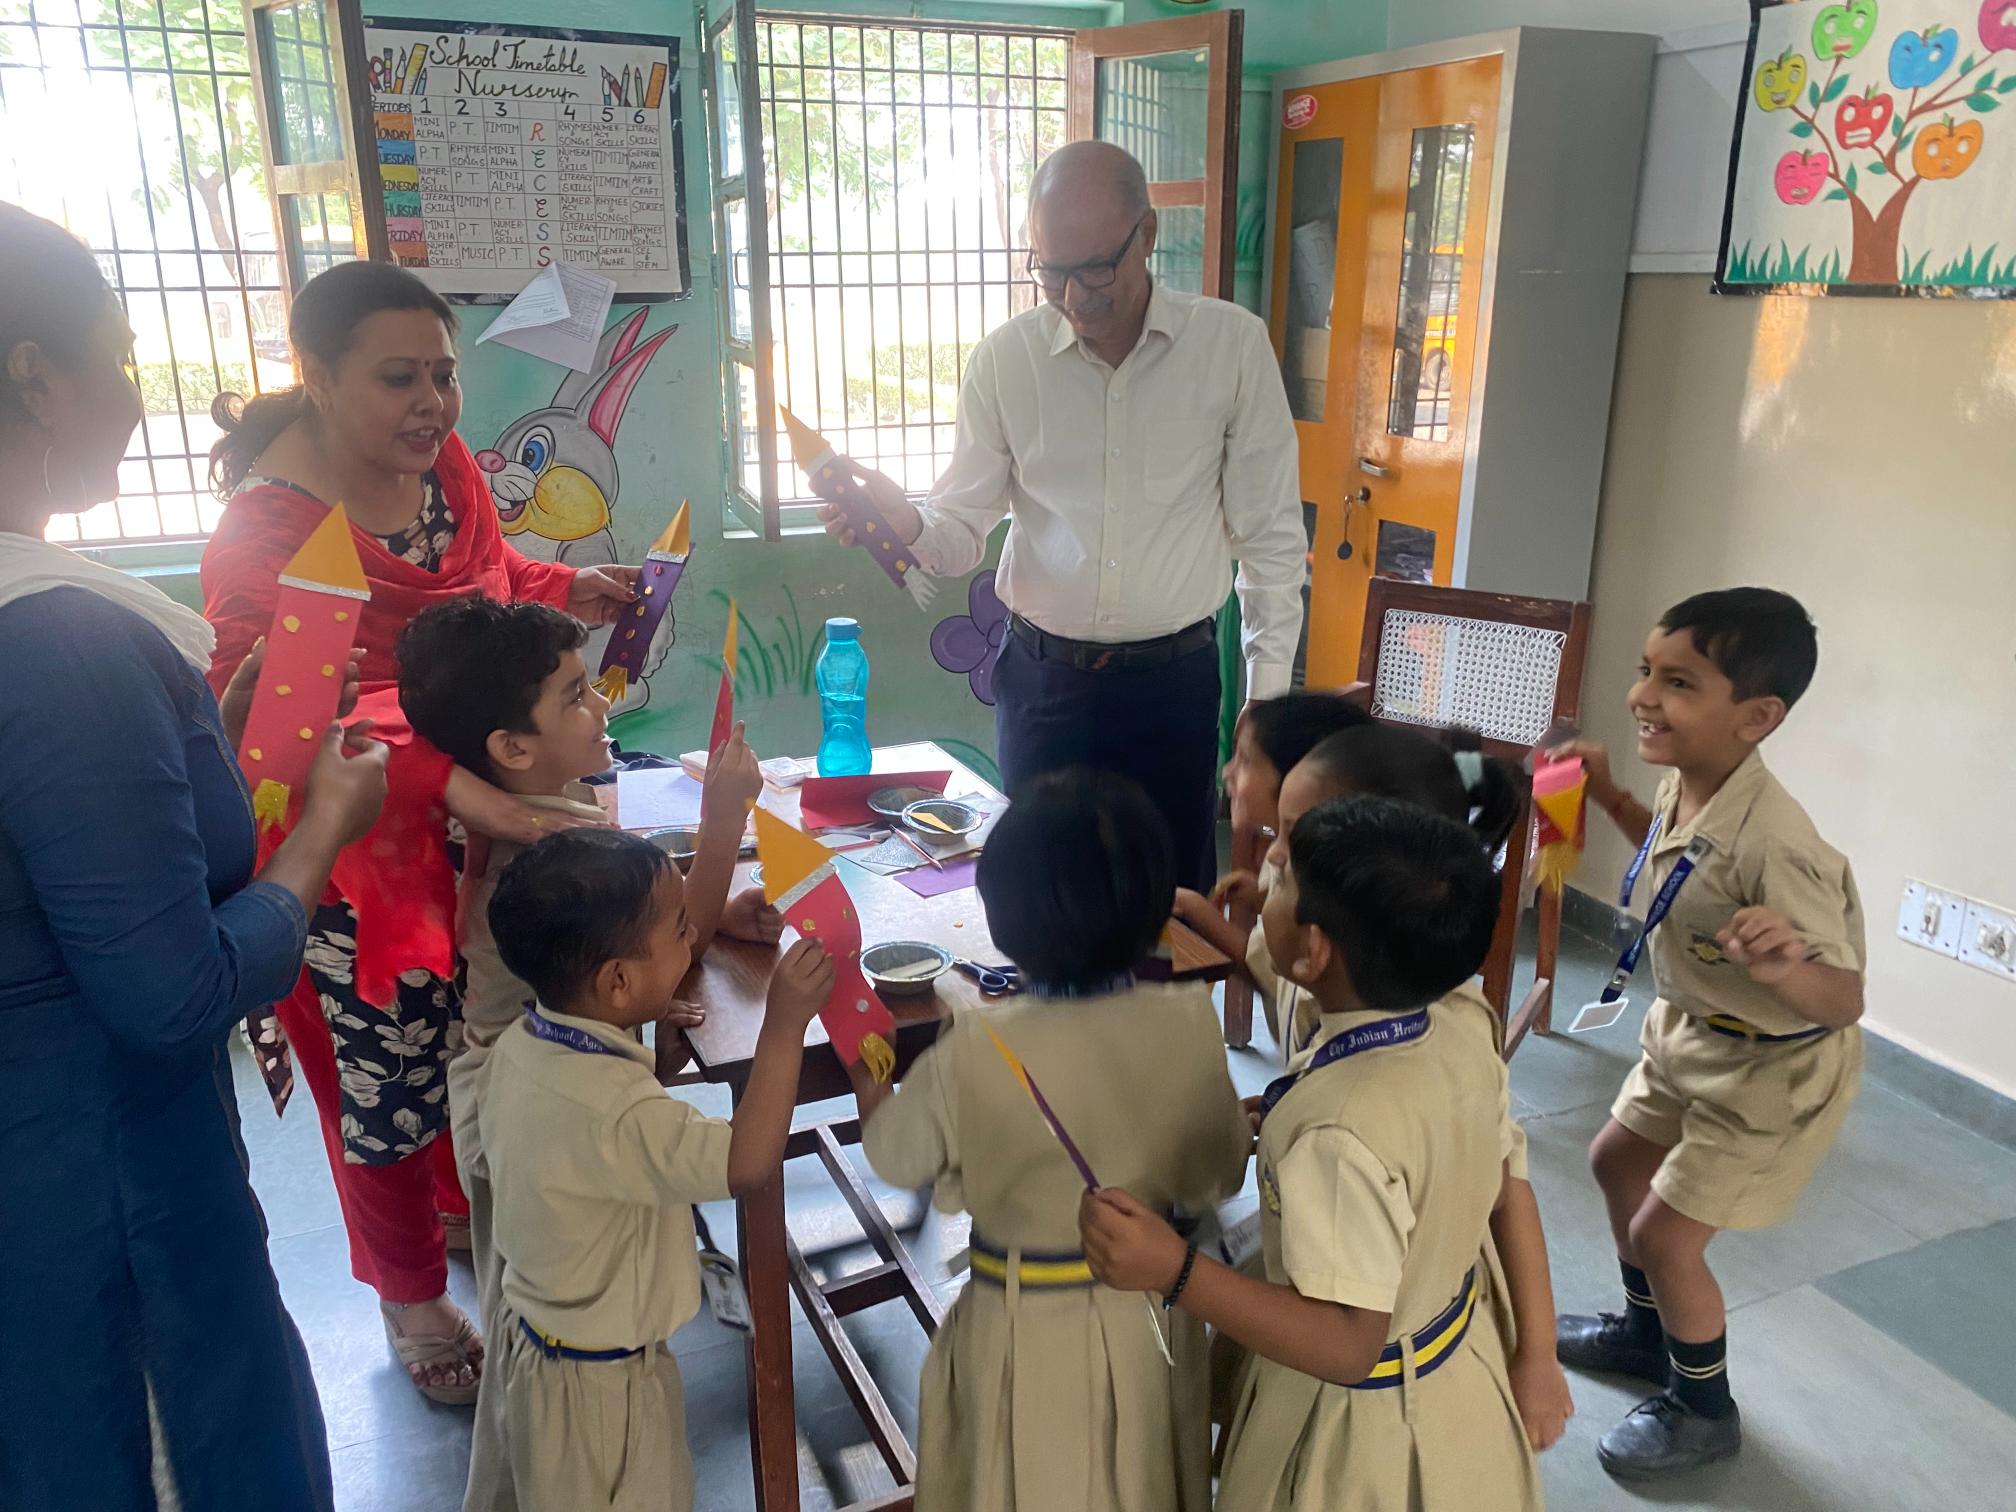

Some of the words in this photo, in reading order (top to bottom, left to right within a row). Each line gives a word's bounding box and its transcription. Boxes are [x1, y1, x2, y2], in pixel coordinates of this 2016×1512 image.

[429, 34, 500, 69] School
[502, 38, 587, 76] Timetable
[420, 97, 432, 114] 1
[455, 99, 470, 115] 2
[494, 101, 507, 117] 3
[564, 105, 576, 121] 4
[601, 107, 615, 123] 5
[633, 109, 645, 124] 6
[414, 116, 440, 127] MINI
[416, 129, 446, 140] ALPHA
[450, 144, 487, 154] RHYMES
[488, 145, 517, 155] MINI
[451, 157, 487, 167] SONGS
[490, 156, 519, 167] ALPHA
[489, 170, 521, 181] MINI
[491, 181, 523, 193] ALPHA
[561, 183, 593, 193] SKILLS
[631, 186, 659, 196] CRAFT
[454, 195, 489, 208] TIMTIM
[424, 203, 455, 214] SKILLS
[562, 211, 595, 221] SKILLS
[596, 211, 630, 223] SONGS
[425, 219, 450, 230] MINI
[427, 231, 456, 241] ALPHA
[566, 232, 595, 243] SKILLS
[461, 246, 495, 261] MUSIC
[429, 256, 460, 267] SKILLS
[1348, 1029, 1389, 1049] Indian
